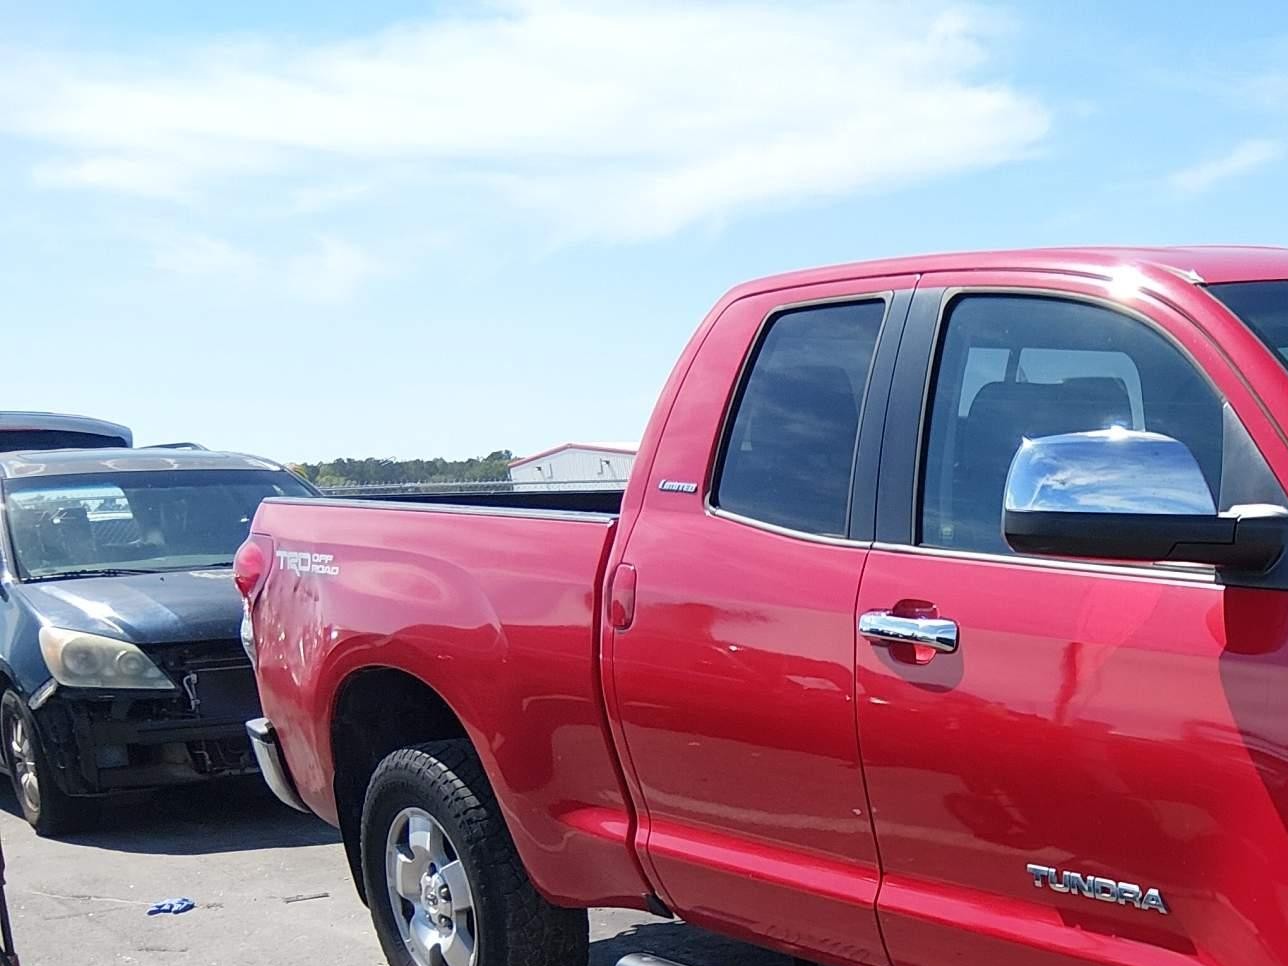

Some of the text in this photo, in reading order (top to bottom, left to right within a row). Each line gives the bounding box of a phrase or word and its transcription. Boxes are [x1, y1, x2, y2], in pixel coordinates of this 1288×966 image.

[312, 553, 334, 563] OFF
[311, 564, 339, 576] ROAD
[1026, 863, 1168, 914] TUNDRA
